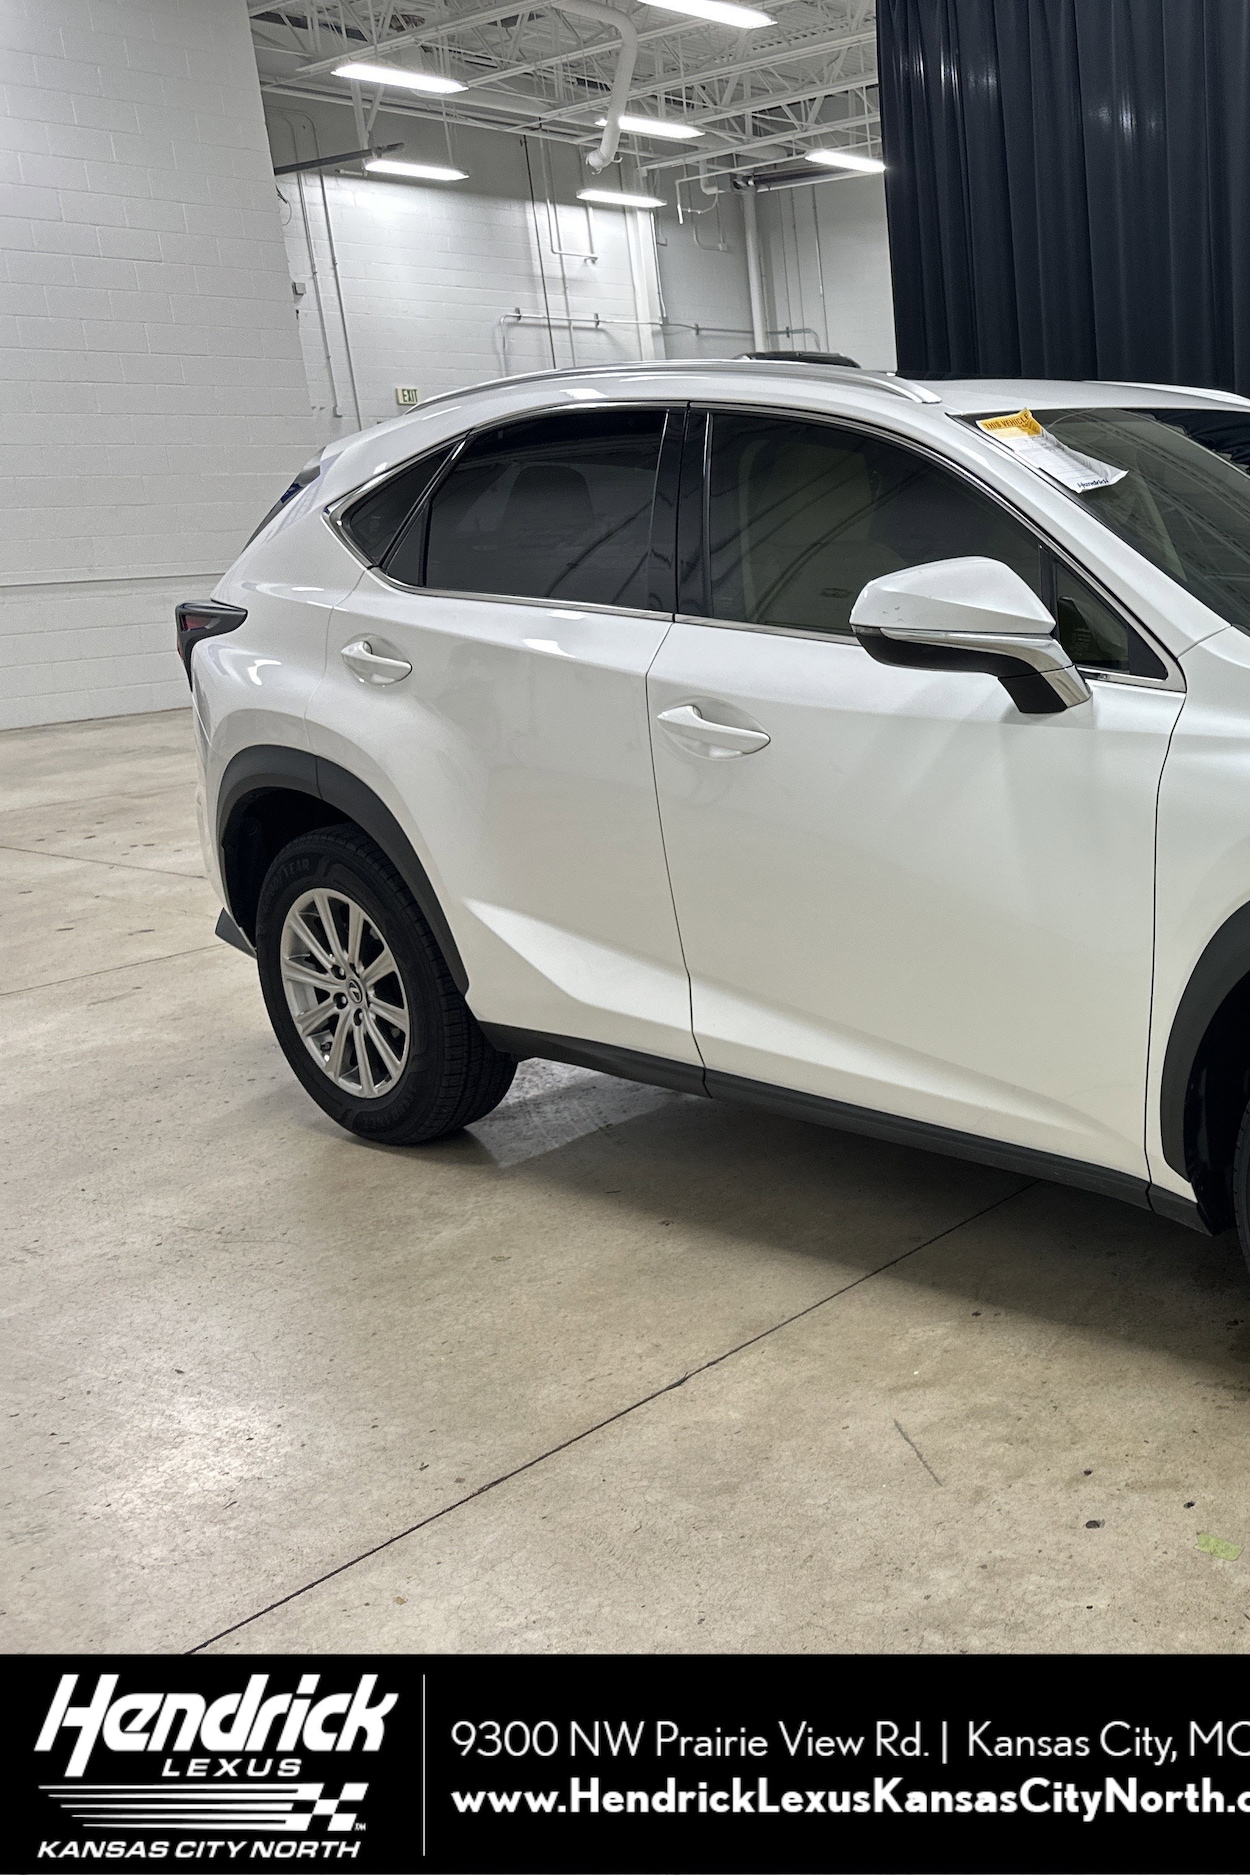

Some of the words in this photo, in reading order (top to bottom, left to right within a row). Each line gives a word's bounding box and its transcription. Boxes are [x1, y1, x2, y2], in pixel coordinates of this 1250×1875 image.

[402, 388, 418, 403] EXIT
[984, 420, 1002, 430] THIS
[1002, 412, 1030, 428] VEHICLE
